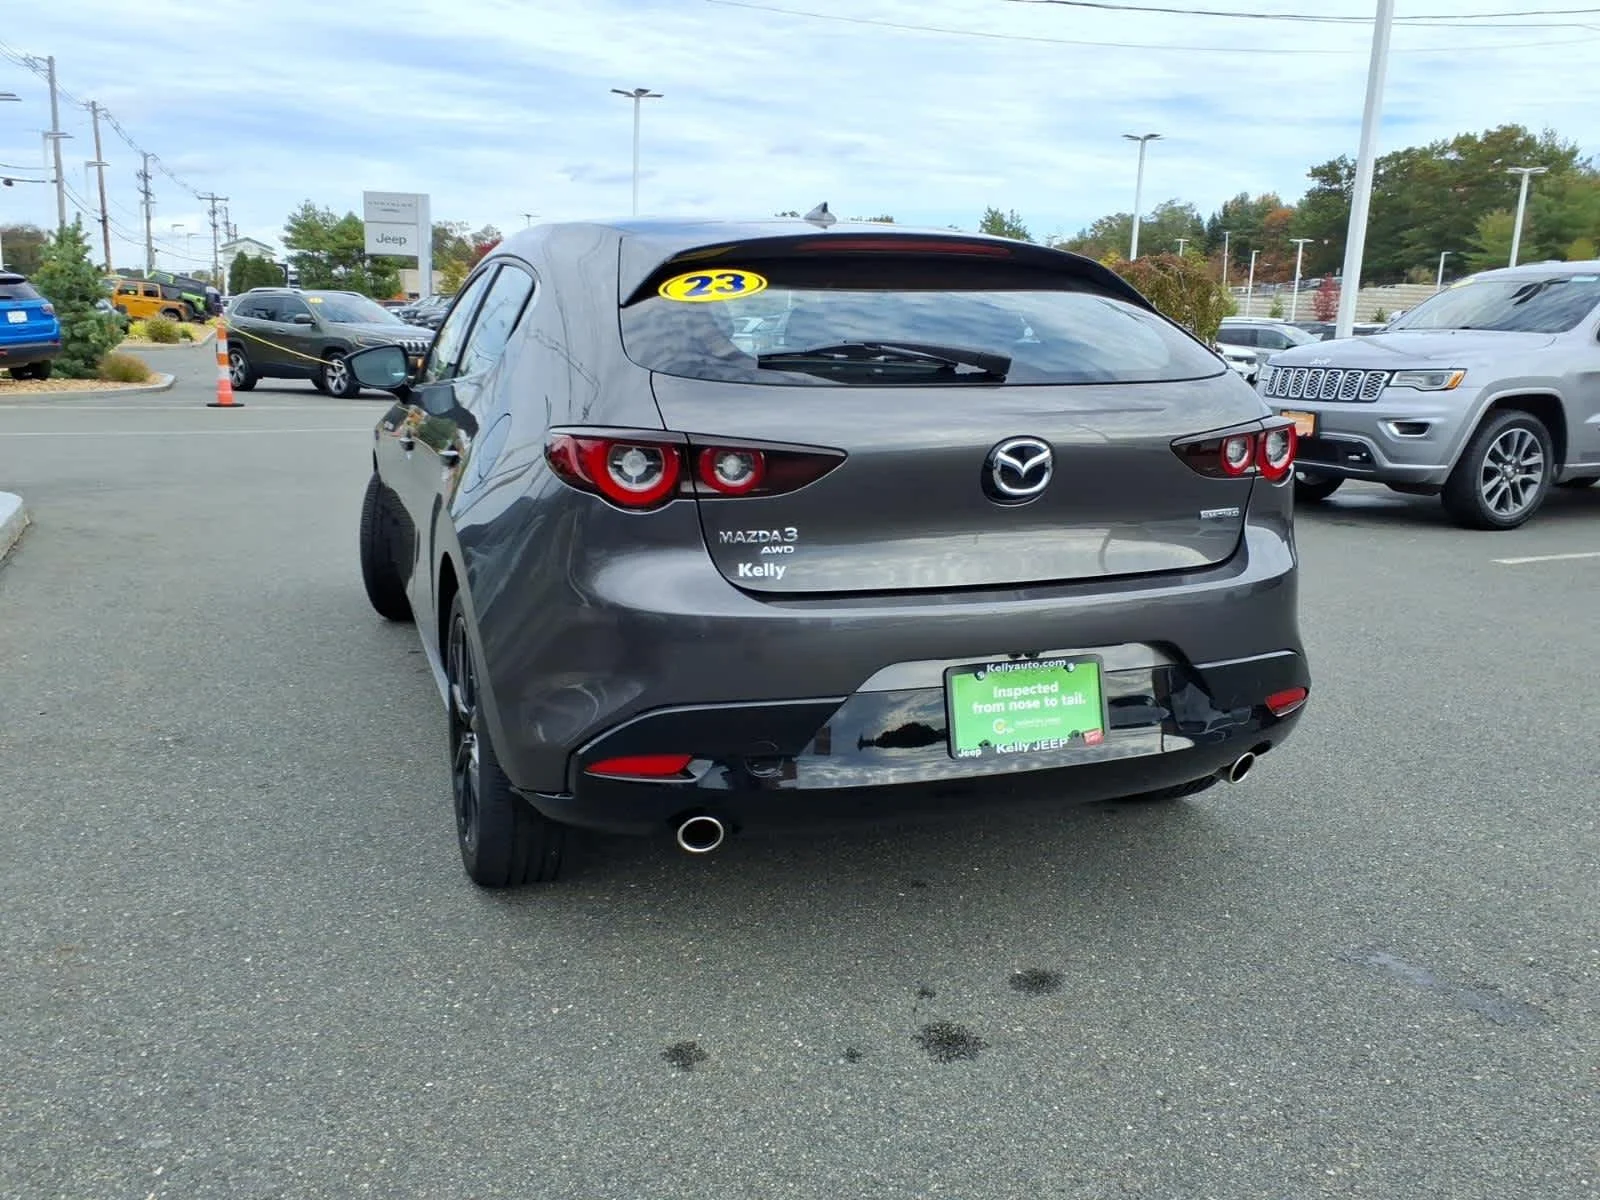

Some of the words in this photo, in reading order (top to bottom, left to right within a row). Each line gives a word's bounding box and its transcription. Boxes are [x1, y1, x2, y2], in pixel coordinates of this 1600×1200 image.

[376, 232, 407, 247] Jeep
[684, 272, 745, 296] 23
[760, 545, 795, 554] AWD
[737, 562, 787, 580] Kelly
[986, 659, 1067, 673] Kellyauto.com
[993, 682, 1059, 700] Inspected
[972, 702, 1005, 714] from
[1009, 700, 1041, 711] nose
[1044, 697, 1057, 707] to
[1061, 693, 1086, 706] tail.
[958, 747, 982, 759] Jeep
[996, 740, 1030, 755] Kelly
[1032, 738, 1069, 751] JEEP
